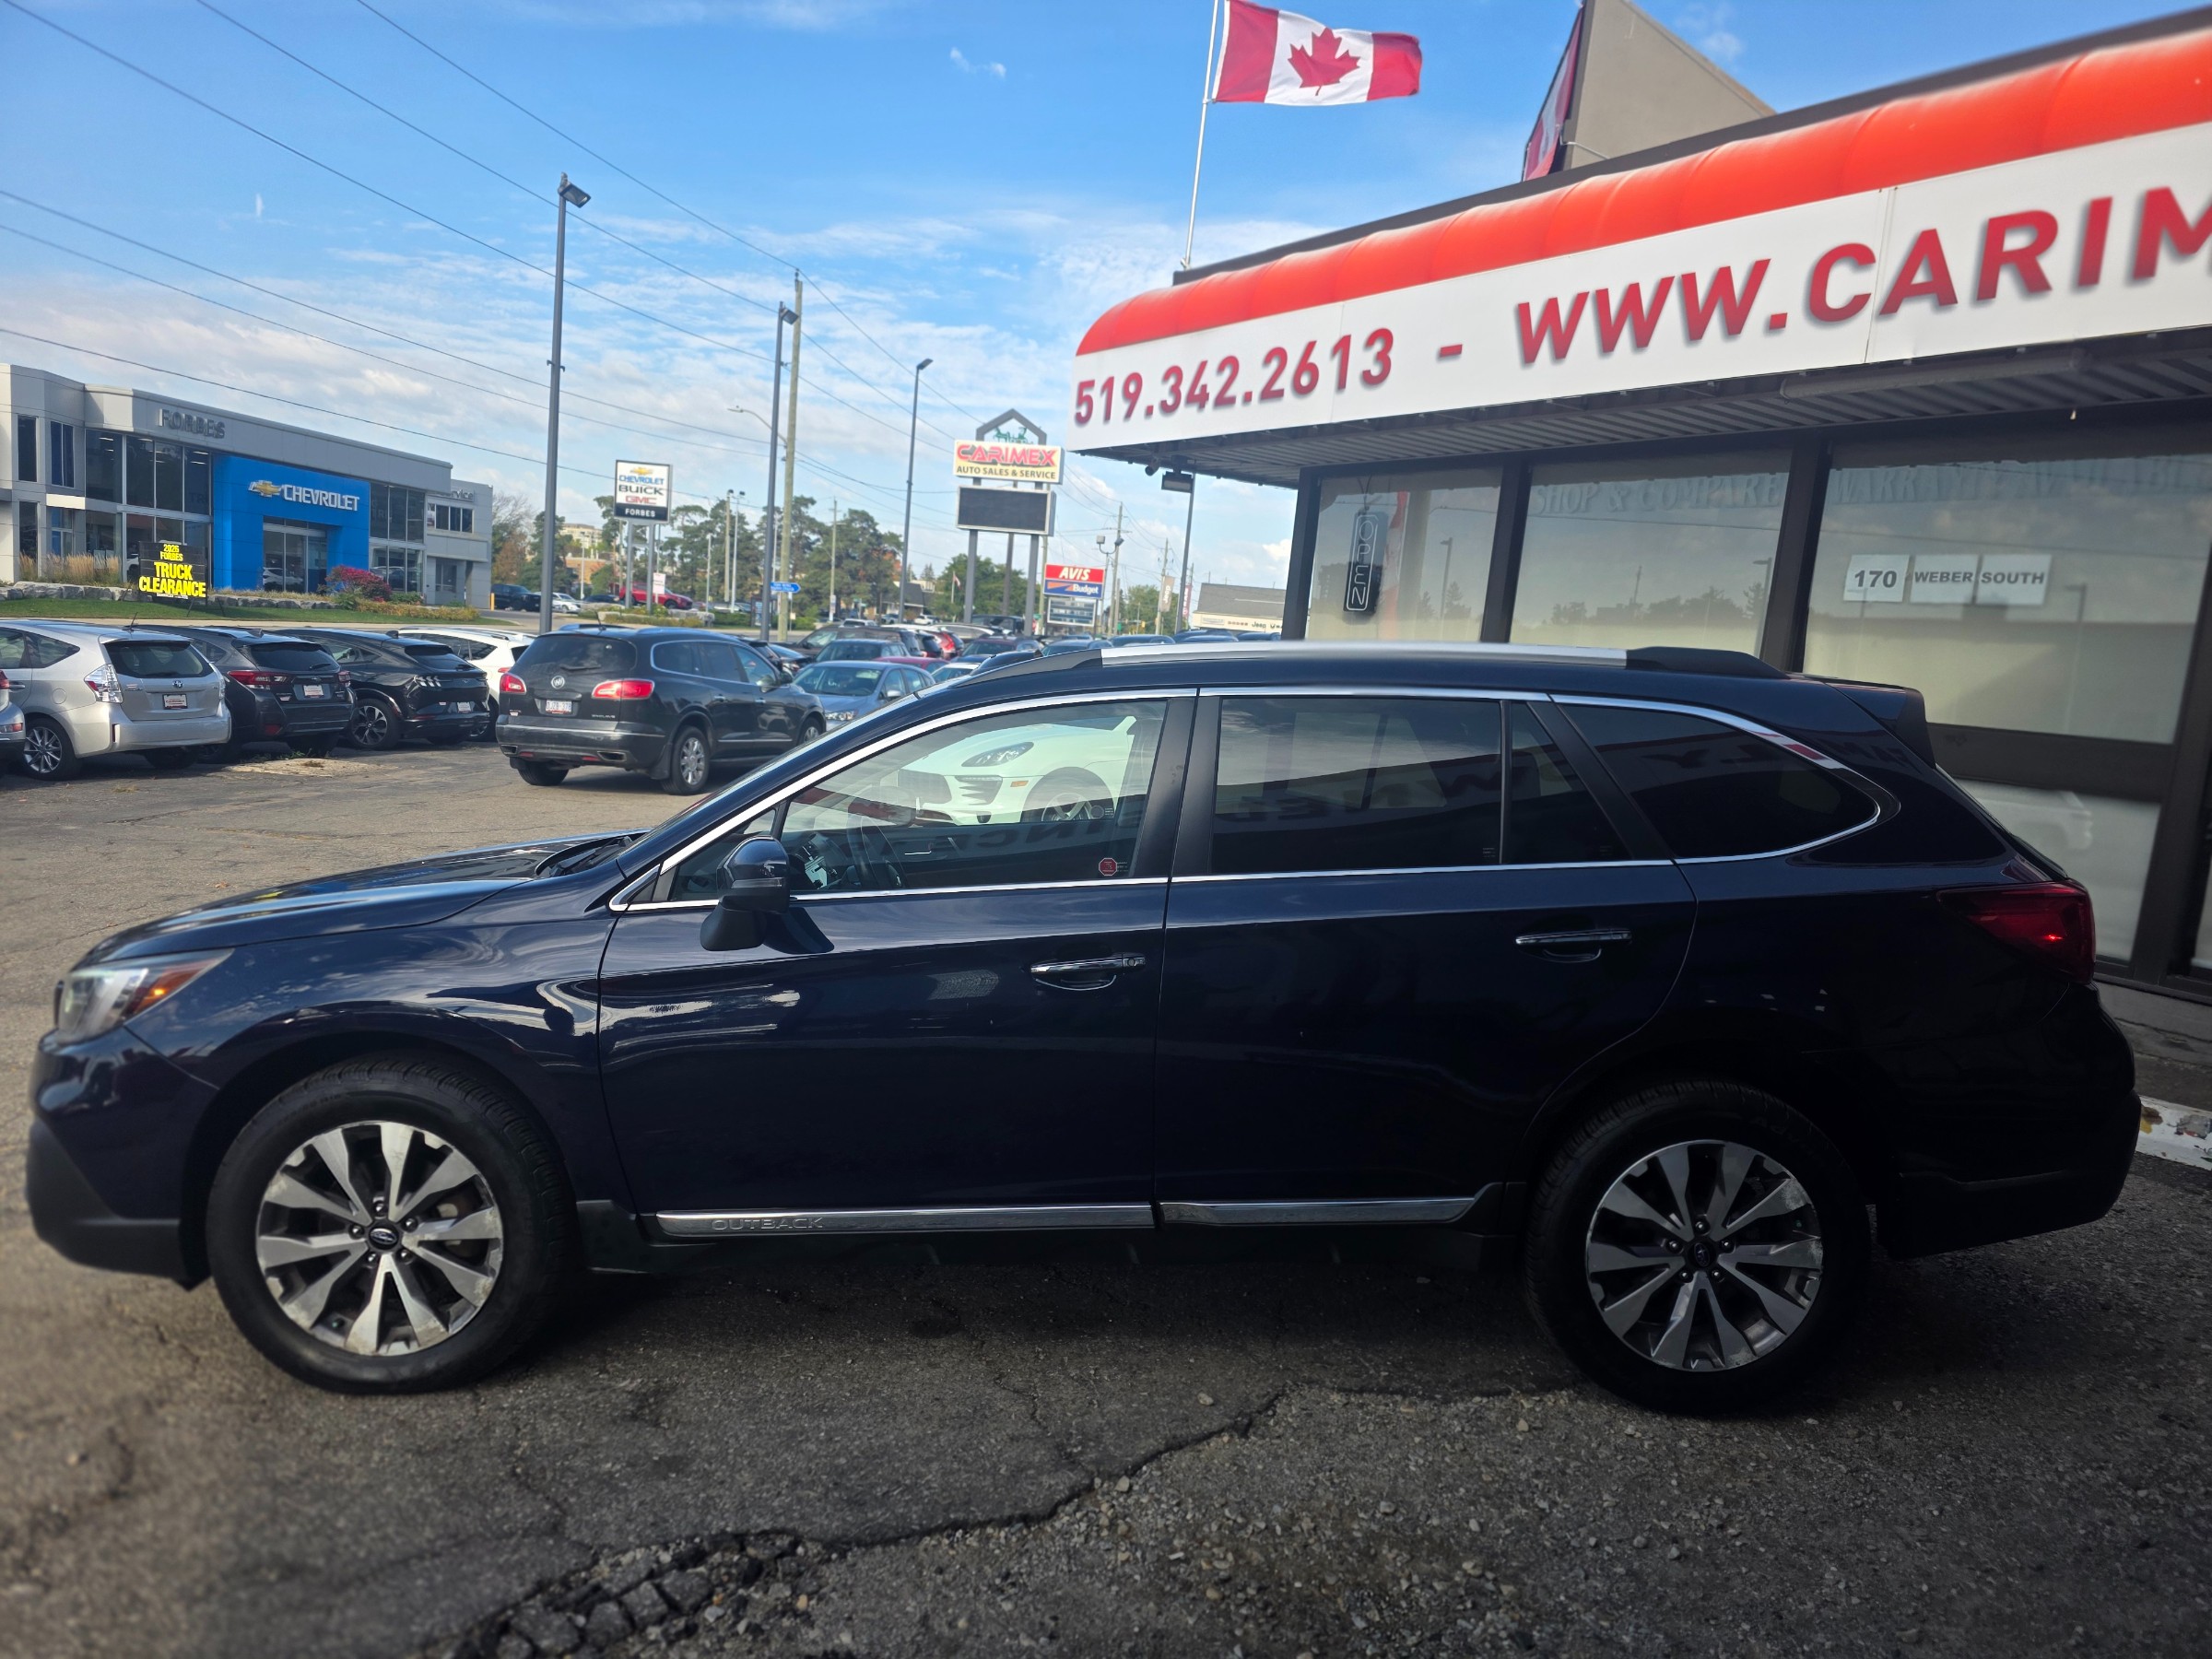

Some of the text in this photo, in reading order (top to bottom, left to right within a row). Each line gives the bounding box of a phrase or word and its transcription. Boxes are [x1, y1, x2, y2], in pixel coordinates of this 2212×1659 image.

[1075, 328, 1394, 425] 519.342.2613
[1439, 343, 1463, 359] -
[159, 408, 225, 439] FORBES
[957, 444, 1058, 466] CARIMEX
[957, 465, 1056, 478] AUTO SALES & SERVICE
[618, 475, 665, 485] CHEVROLET
[283, 484, 359, 512] CHEVROLET
[618, 484, 665, 496] BUICK
[625, 495, 657, 504] GMC
[1535, 485, 1599, 515] SHOP
[625, 508, 656, 517] FORBES
[160, 551, 183, 561] FORBES
[1351, 520, 1374, 606] OPEN
[154, 561, 193, 580] TRUCK
[1058, 567, 1091, 582] AVIS
[139, 576, 206, 597] CLEARANCE
[1854, 570, 2045, 588] 170 WEBER SOUTH
[1072, 583, 1099, 594] Budget
[712, 1217, 823, 1230] OUTBACK
